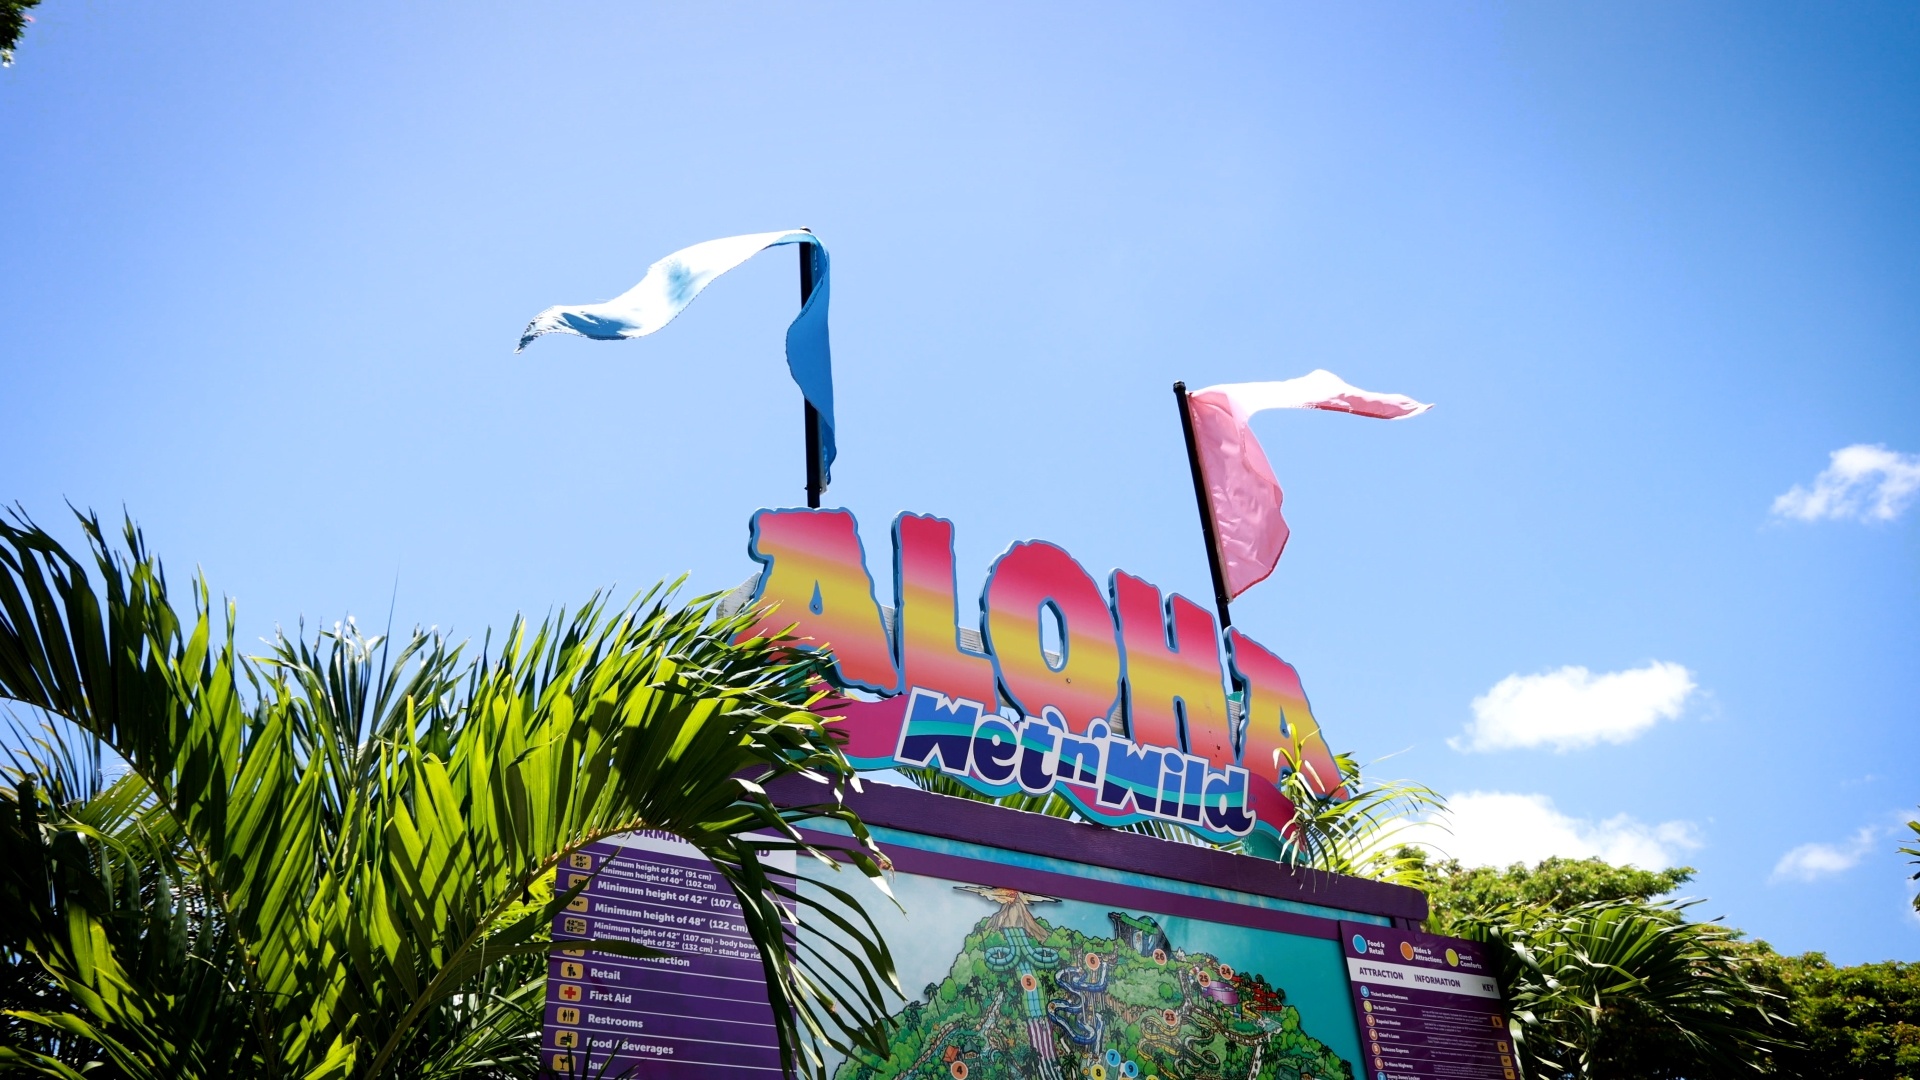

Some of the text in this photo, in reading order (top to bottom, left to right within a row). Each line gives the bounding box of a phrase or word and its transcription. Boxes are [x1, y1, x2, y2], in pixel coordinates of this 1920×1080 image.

[732, 506, 1350, 801] ALOHA
[599, 856, 634, 868] Mnimum
[636, 863, 660, 873] height
[635, 872, 659, 882] height
[686, 880, 702, 888] (102
[598, 881, 643, 895] Minimum
[646, 888, 676, 901] height
[711, 898, 731, 907] (107
[595, 903, 641, 917] Minimum
[644, 911, 674, 923] height
[709, 920, 729, 929] (122
[731, 924, 748, 933] cm)
[593, 931, 629, 942] Minimum
[631, 936, 655, 946] height
[594, 922, 630, 933] Minimum
[632, 928, 656, 937] height
[683, 934, 699, 942] (107
[720, 939, 738, 948] body
[1367, 940, 1380, 948] Food
[1415, 954, 1442, 964] Attractions
[591, 968, 620, 980] Retail
[1360, 967, 1494, 992] ATTRACTION INFORMATION KEY
[1026, 978, 1031, 986] 5
[590, 990, 632, 1004] First Aid
[588, 1014, 643, 1028] Restrooms
[621, 1041, 674, 1055] Beverages
[957, 1066, 962, 1074] 4
[1096, 1068, 1101, 1077] 8
